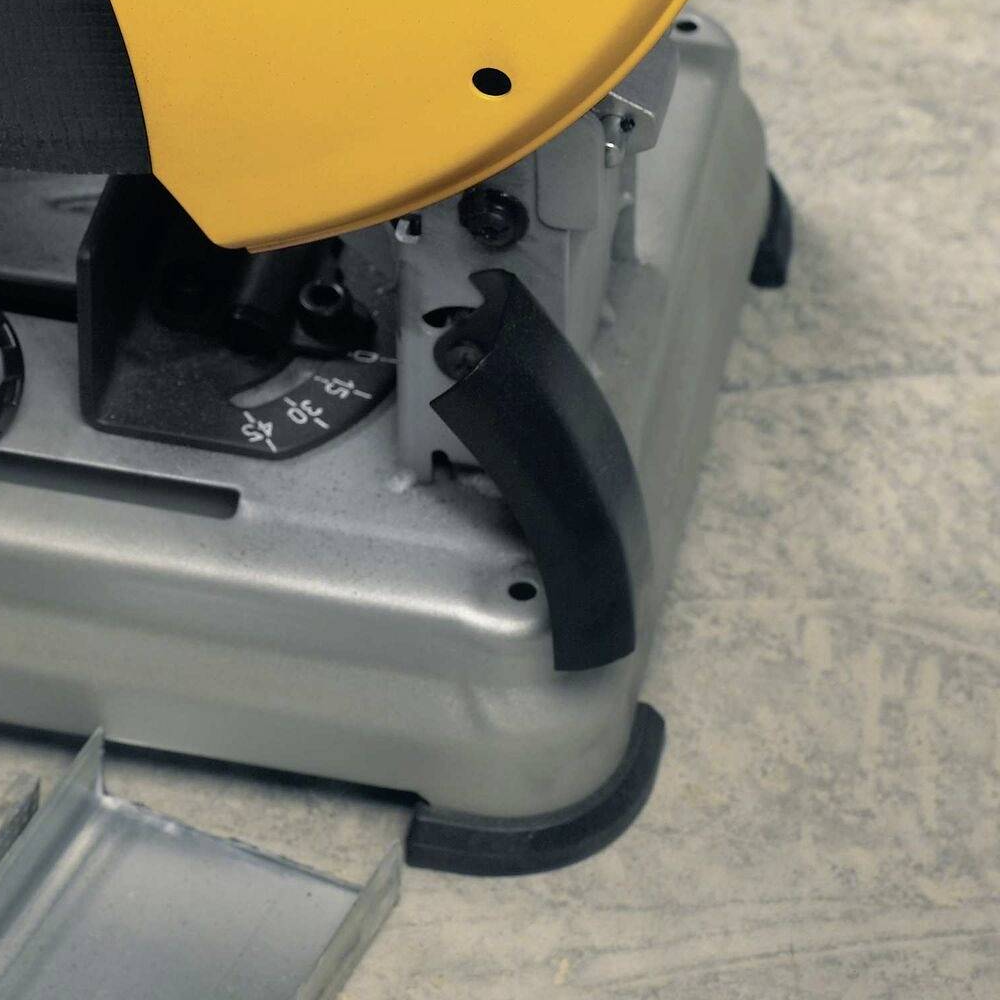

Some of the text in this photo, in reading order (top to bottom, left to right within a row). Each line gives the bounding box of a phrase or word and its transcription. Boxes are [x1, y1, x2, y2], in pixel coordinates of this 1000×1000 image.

[324, 377, 355, 400] 15
[286, 399, 324, 425] 30
[241, 420, 273, 443] 45
